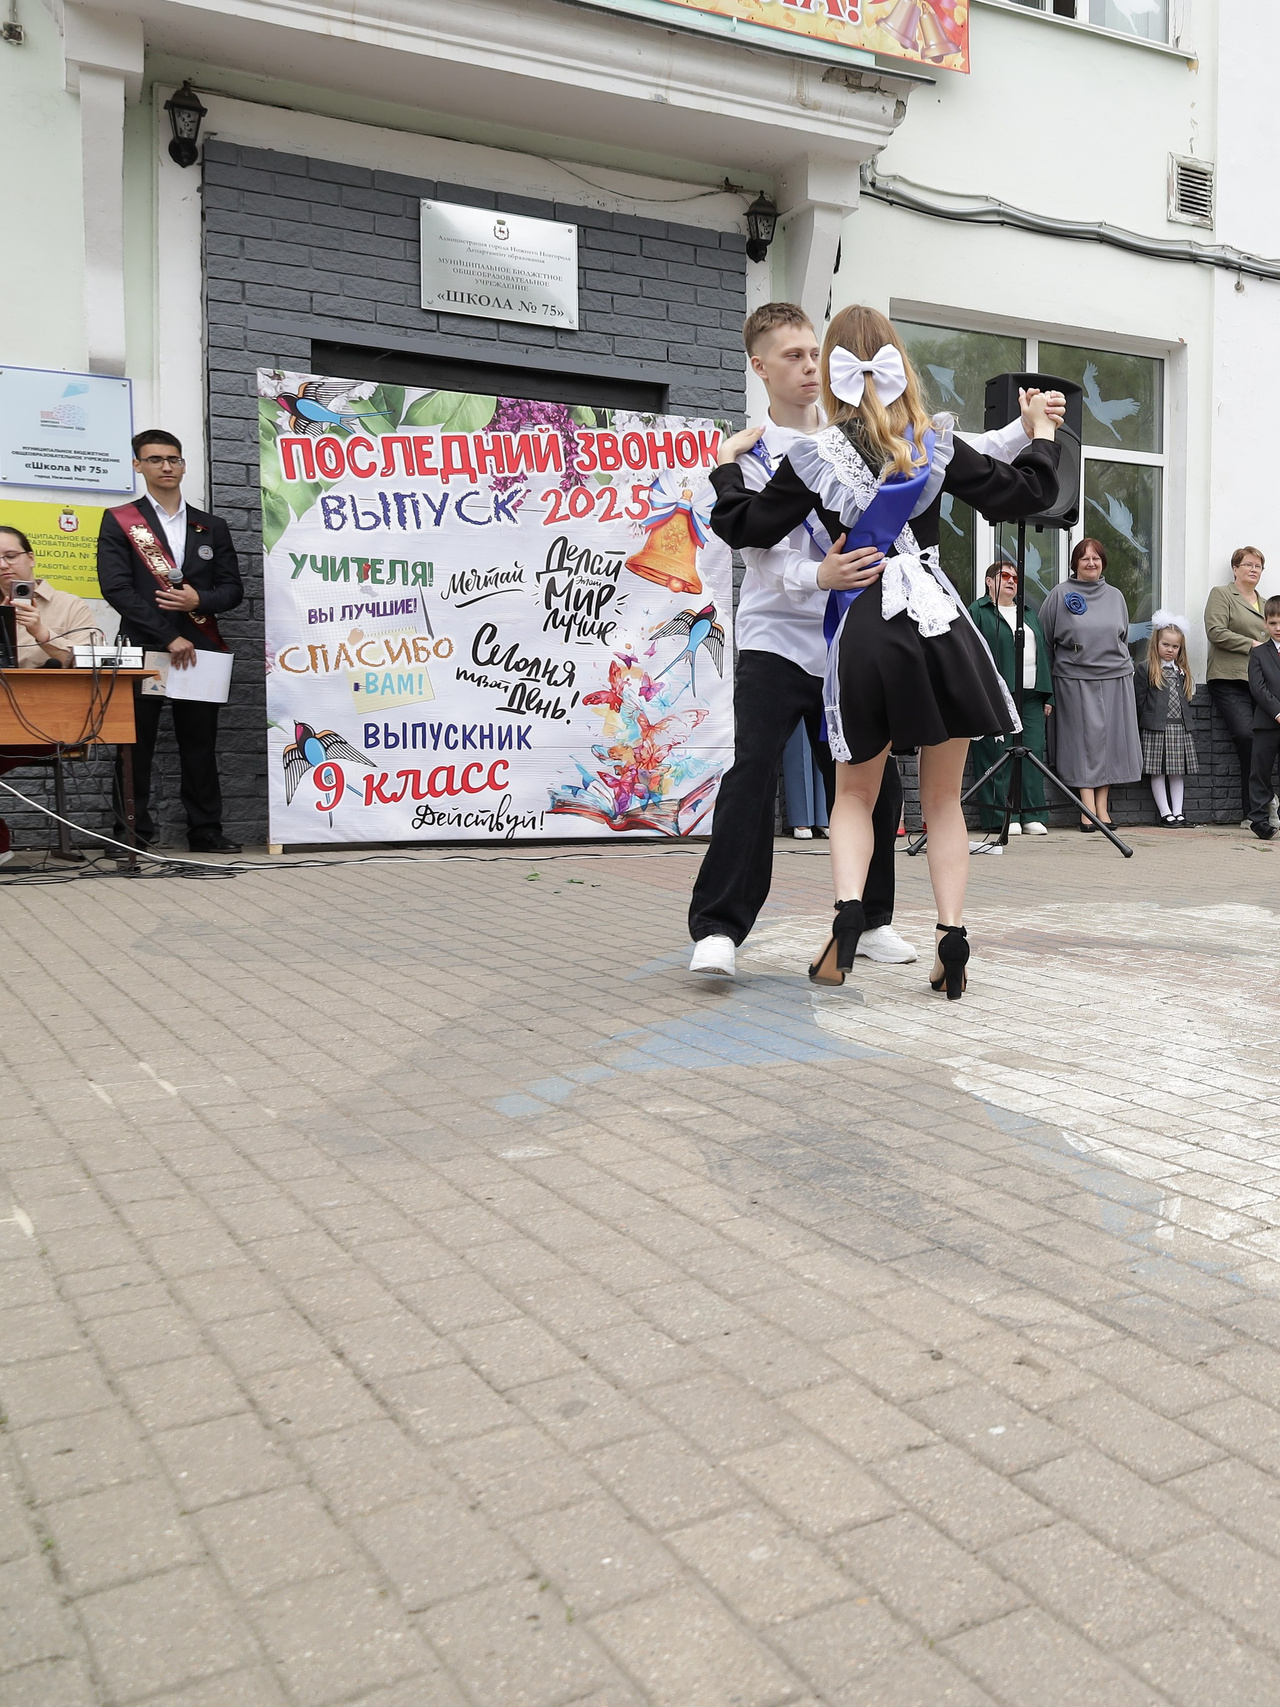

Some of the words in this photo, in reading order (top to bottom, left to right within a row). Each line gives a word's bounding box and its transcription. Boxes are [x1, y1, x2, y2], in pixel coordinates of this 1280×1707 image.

[438, 257, 511, 273] МУНИЦИПАЛЬНОЕ
[512, 268, 563, 282] БЮДЖЕТНОЕ
[453, 267, 550, 287] ОБЩЕОБРАЗОВАТЕЛЬНОЕ
[475, 278, 529, 292] УЧРЕЖДЕНИЕ
[437, 290, 513, 310] «ШКОЛА
[517, 300, 537, 314] №
[541, 304, 564, 317] 75»
[25, 461, 71, 472] «Школа
[74, 465, 87, 473] №
[89, 466, 108, 475] 75»
[279, 429, 563, 484] ПОСЛЕДНИЙ
[576, 428, 721, 472] ЗВОНОК
[320, 486, 523, 532] ВЫПУСК
[540, 485, 653, 526] 2025
[25, 533, 80, 541] ИЦИПАЛЬНОЕ
[35, 549, 77, 558] ШКОЛА
[288, 552, 434, 587] УЧИТЕЛЯ!
[536, 536, 626, 584] Делай
[440, 560, 528, 600] Мечтай
[307, 606, 335, 625] ВЫ
[339, 597, 418, 621] ЛУЧШИЕ!
[544, 576, 616, 620] Мир
[277, 634, 455, 675] СПАСИБО
[471, 622, 576, 688] Сегодня
[364, 673, 425, 697] ВАМ!
[495, 682, 580, 725] День!
[363, 721, 533, 751] ВЫПУСКНИК
[312, 761, 345, 812] 9
[362, 759, 509, 807] класс
[411, 793, 545, 840] Действуй!
